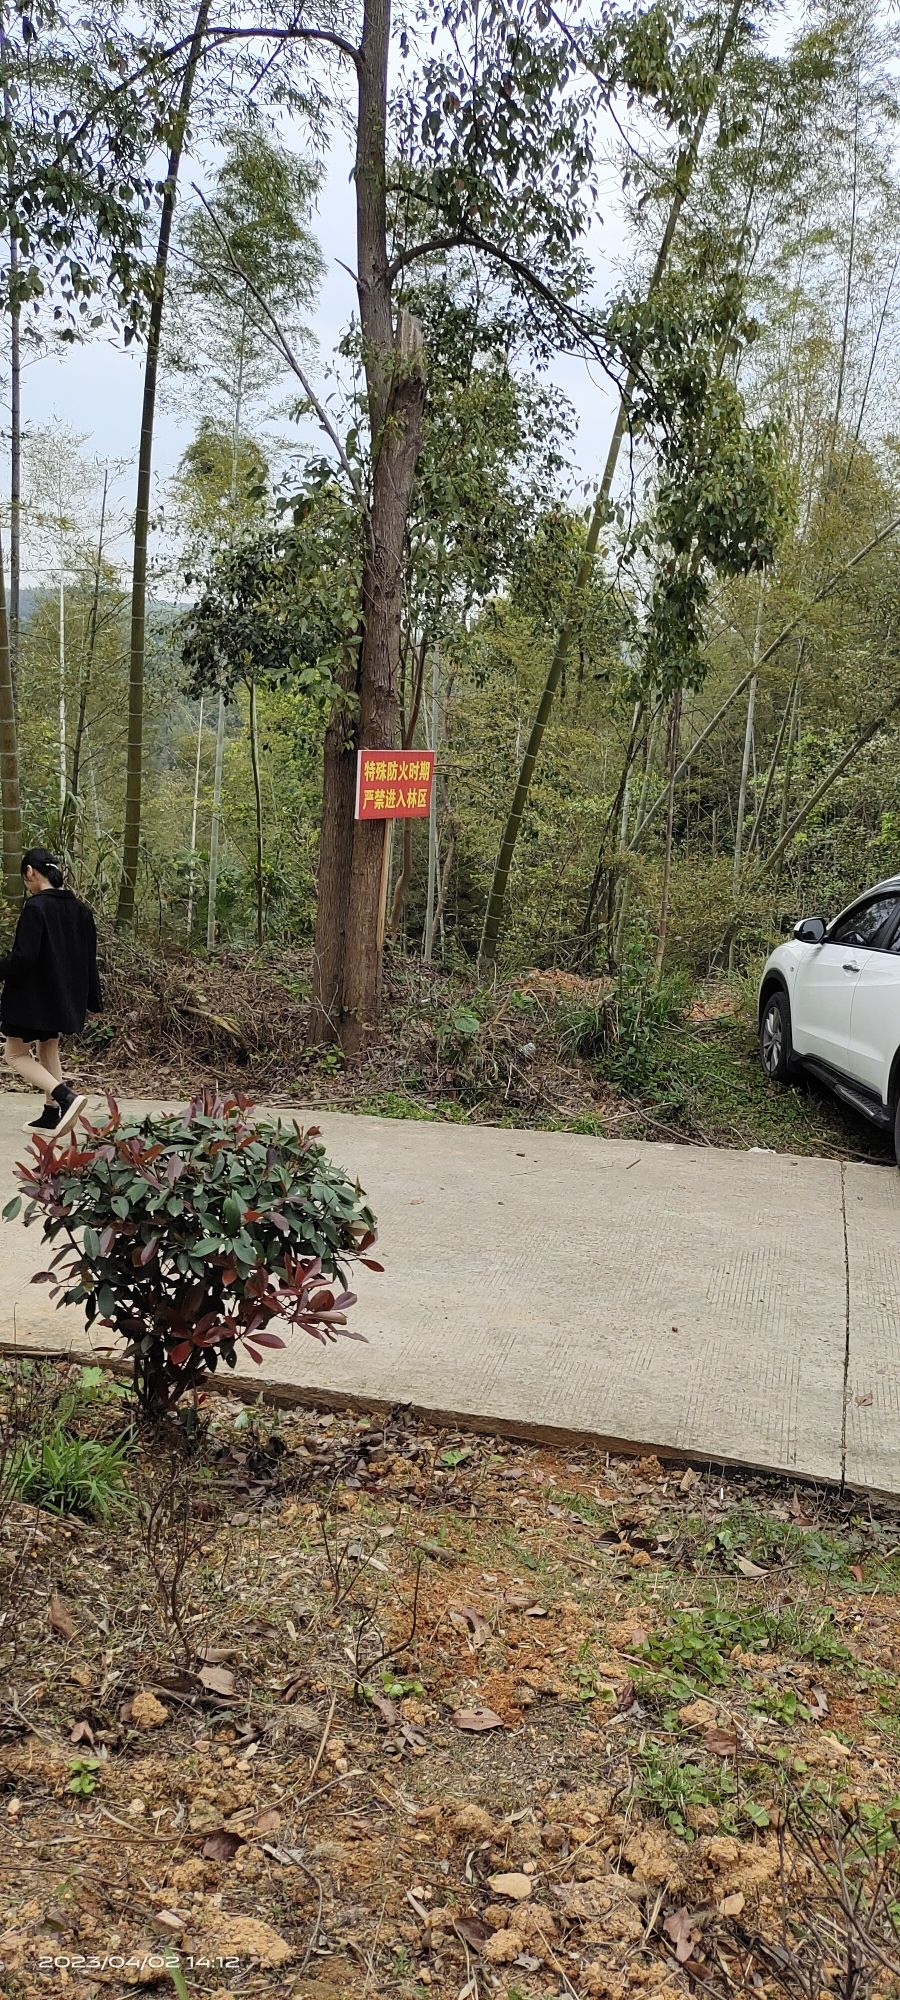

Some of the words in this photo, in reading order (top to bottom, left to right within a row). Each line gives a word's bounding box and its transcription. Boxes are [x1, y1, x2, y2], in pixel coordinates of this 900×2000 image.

[364, 760, 431, 781] 特殊防火时期
[363, 788, 428, 810] 严禁进入林区
